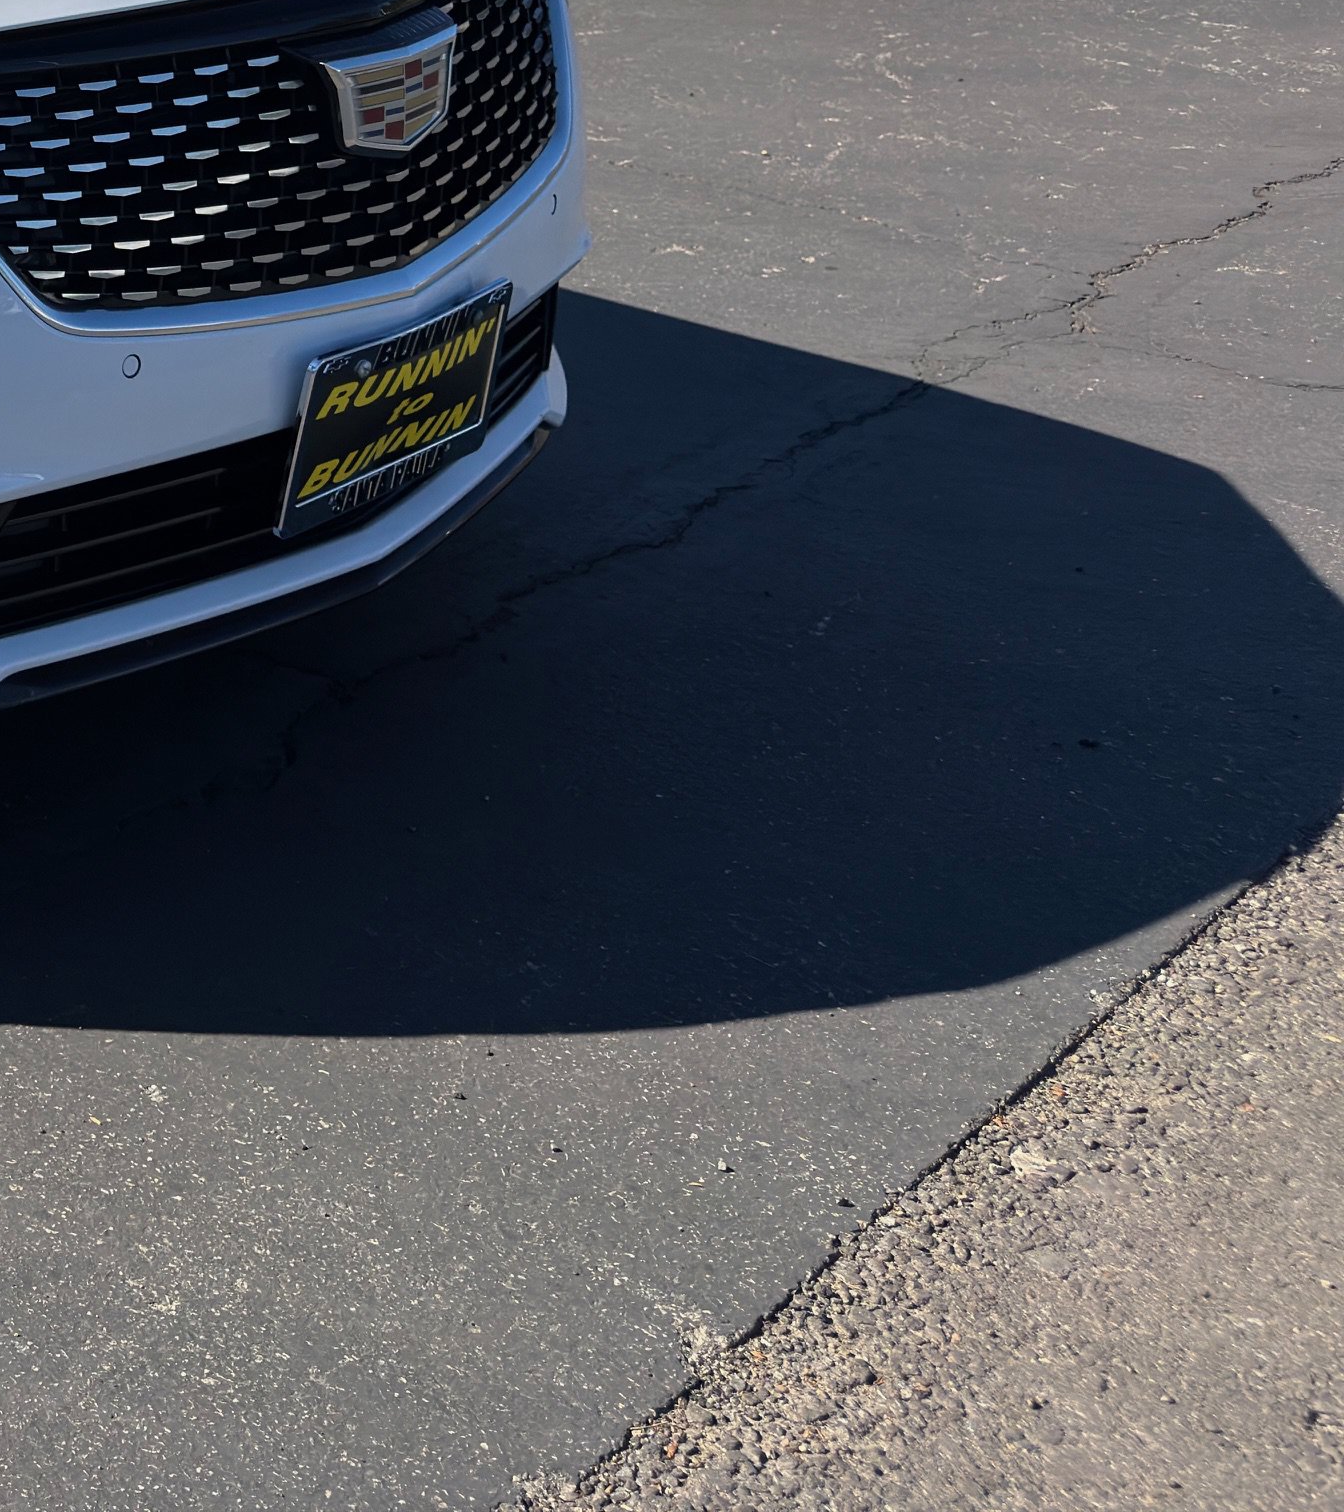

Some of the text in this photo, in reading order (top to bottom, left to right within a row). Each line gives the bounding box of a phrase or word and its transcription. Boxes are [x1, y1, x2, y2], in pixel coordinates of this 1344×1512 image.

[315, 316, 496, 421] RUNNIN'
[386, 392, 434, 425] to
[296, 393, 477, 500] BUNNIN
